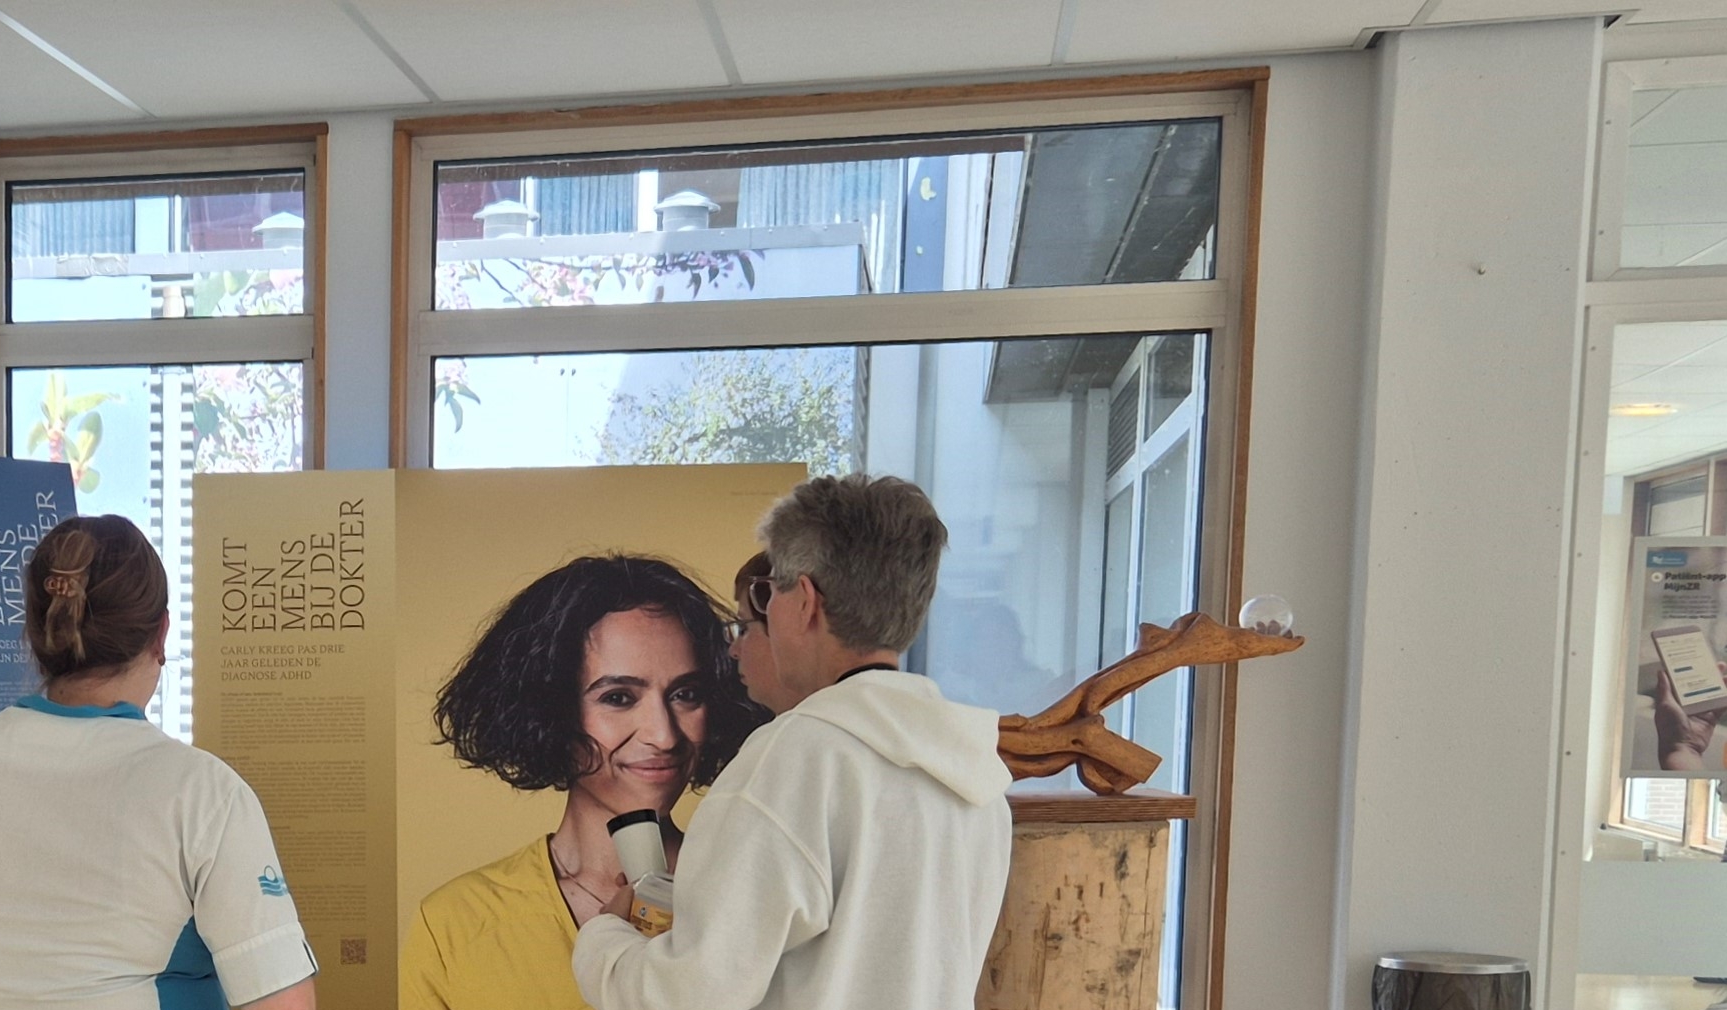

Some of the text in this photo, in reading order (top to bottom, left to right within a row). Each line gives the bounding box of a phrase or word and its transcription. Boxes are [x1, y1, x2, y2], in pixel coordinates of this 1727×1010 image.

[222, 537, 248, 632] KOMT
[251, 566, 277, 632] EEN
[280, 539, 306, 632] MENS
[309, 532, 336, 632] BIJ DE
[339, 498, 365, 631] DOKTER
[220, 644, 346, 656] CARLY KREEG PAS DRIE
[220, 657, 322, 669] JAAR GELEDEN DE
[221, 670, 312, 681] DIAGNOSE ADHD
